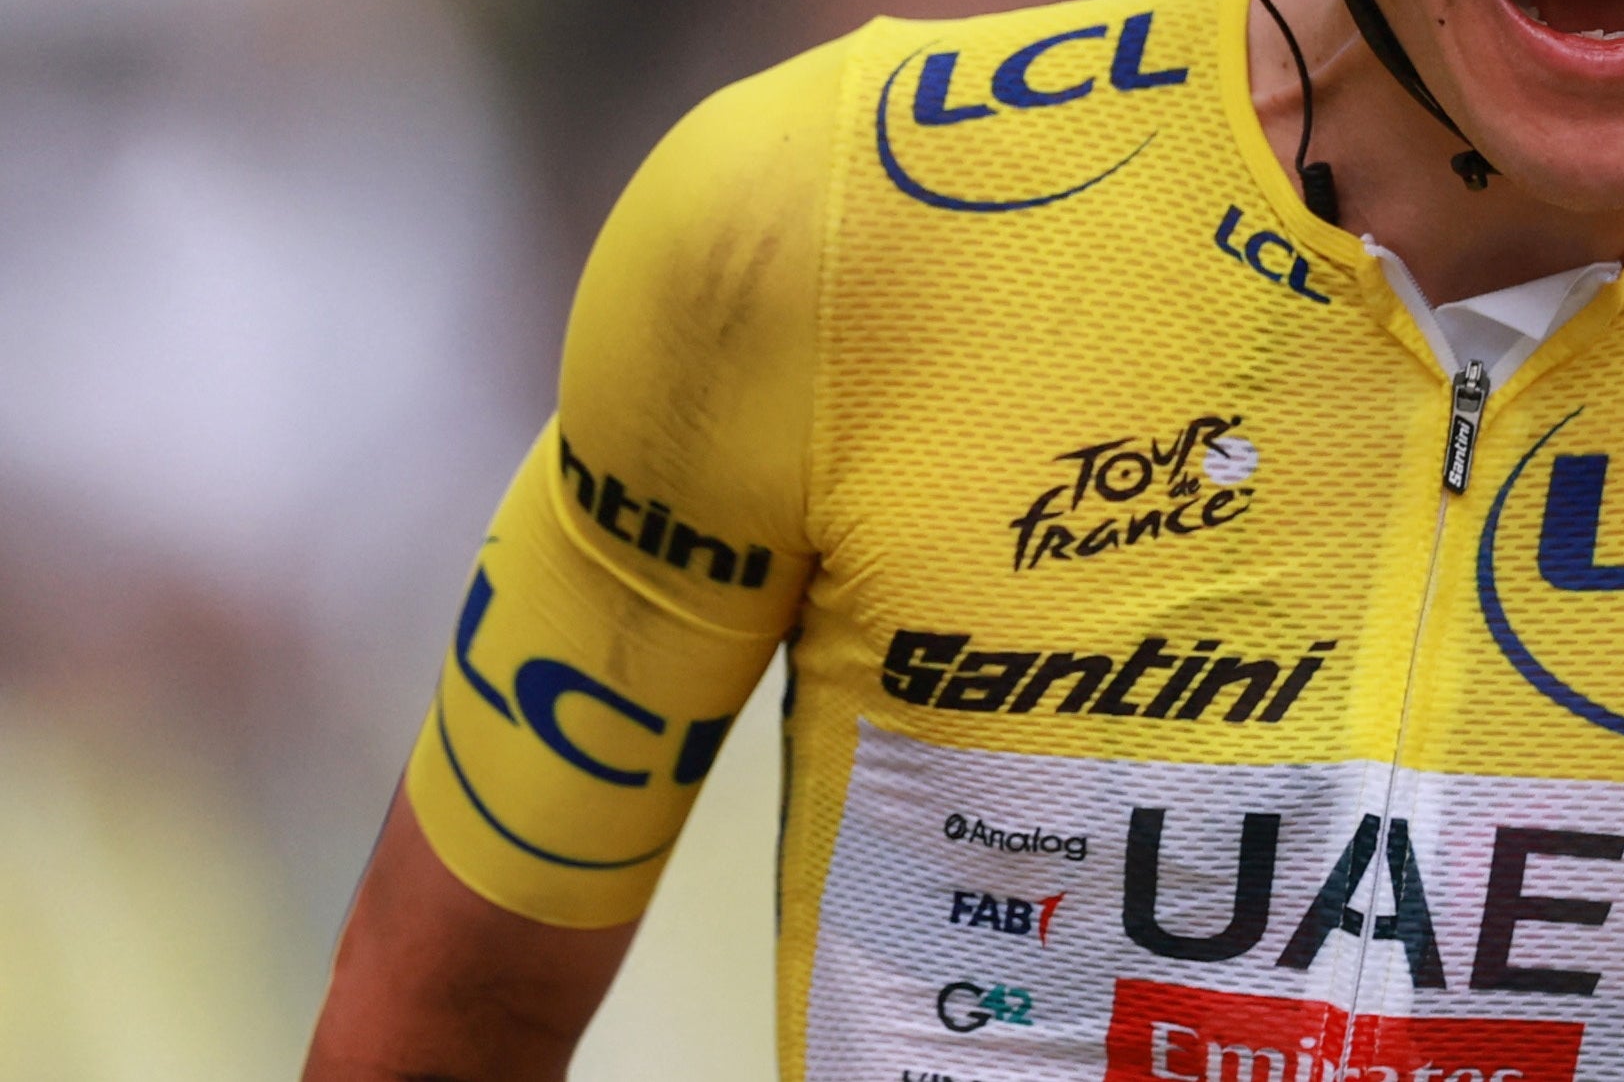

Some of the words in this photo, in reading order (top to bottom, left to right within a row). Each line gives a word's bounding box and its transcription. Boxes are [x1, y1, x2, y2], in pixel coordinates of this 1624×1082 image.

[914, 11, 1190, 126] LCL
[1215, 204, 1332, 304] LCL
[1168, 470, 1202, 498] de
[1448, 419, 1471, 489] Santini
[560, 431, 773, 590] ntini
[881, 629, 1338, 723] Santini
[969, 819, 1088, 861] Analog
